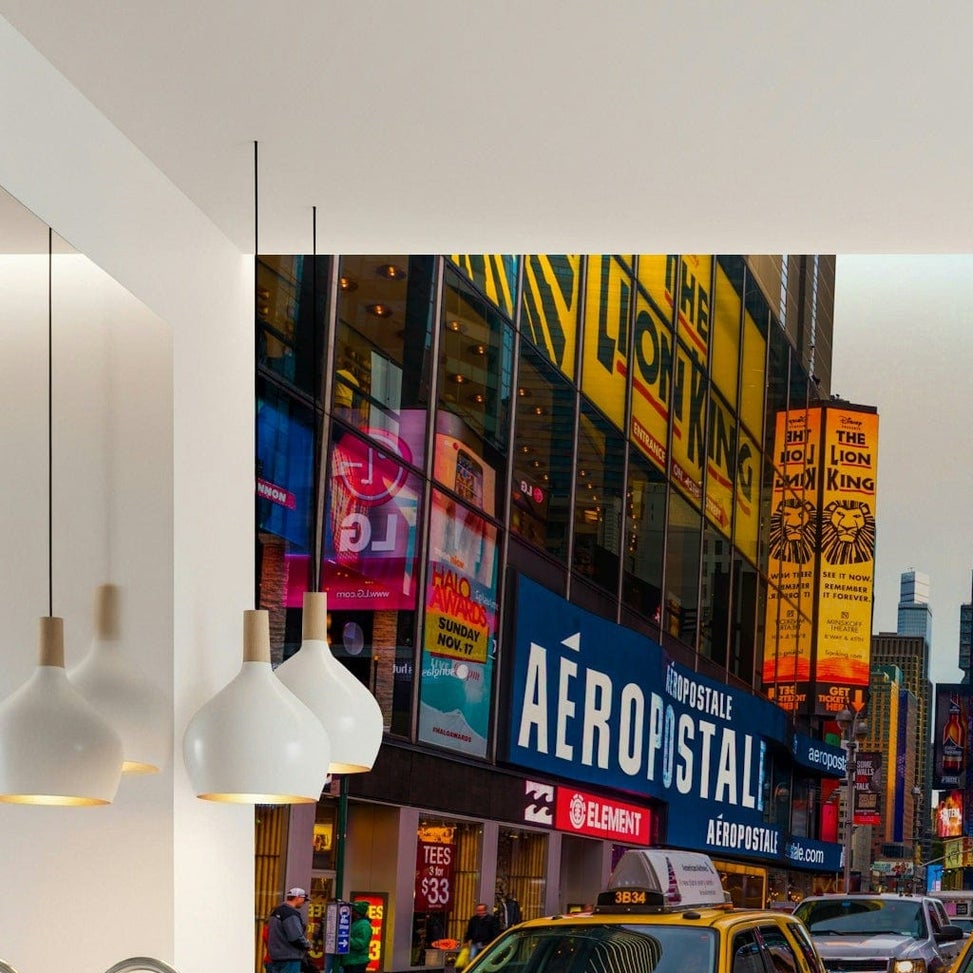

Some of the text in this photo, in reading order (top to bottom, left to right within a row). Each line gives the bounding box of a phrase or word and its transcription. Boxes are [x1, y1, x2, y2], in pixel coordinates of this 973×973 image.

[633, 422, 665, 463] ENTRANCE
[836, 429, 866, 445] THE
[831, 445, 871, 466] LION
[827, 467, 875, 491] KING
[822, 571, 836, 579] SEE
[849, 574, 872, 582] NOW.
[824, 583, 868, 594] REMEMBER
[833, 592, 871, 602] FOREVER.
[438, 616, 480, 642] SUNDAY
[437, 633, 474, 655] NOV. 17
[665, 661, 732, 721] AÉROPOSTALE
[829, 686, 851, 696] GET
[857, 768, 875, 776] WALLS
[857, 782, 870, 790] TALK
[587, 801, 642, 836] ELEMENT
[706, 814, 778, 854] AÉROPOSTALE
[423, 845, 451, 865] TEES
[429, 866, 444, 876] 3 for
[421, 877, 450, 904] $33
[614, 891, 647, 905] 3B34
